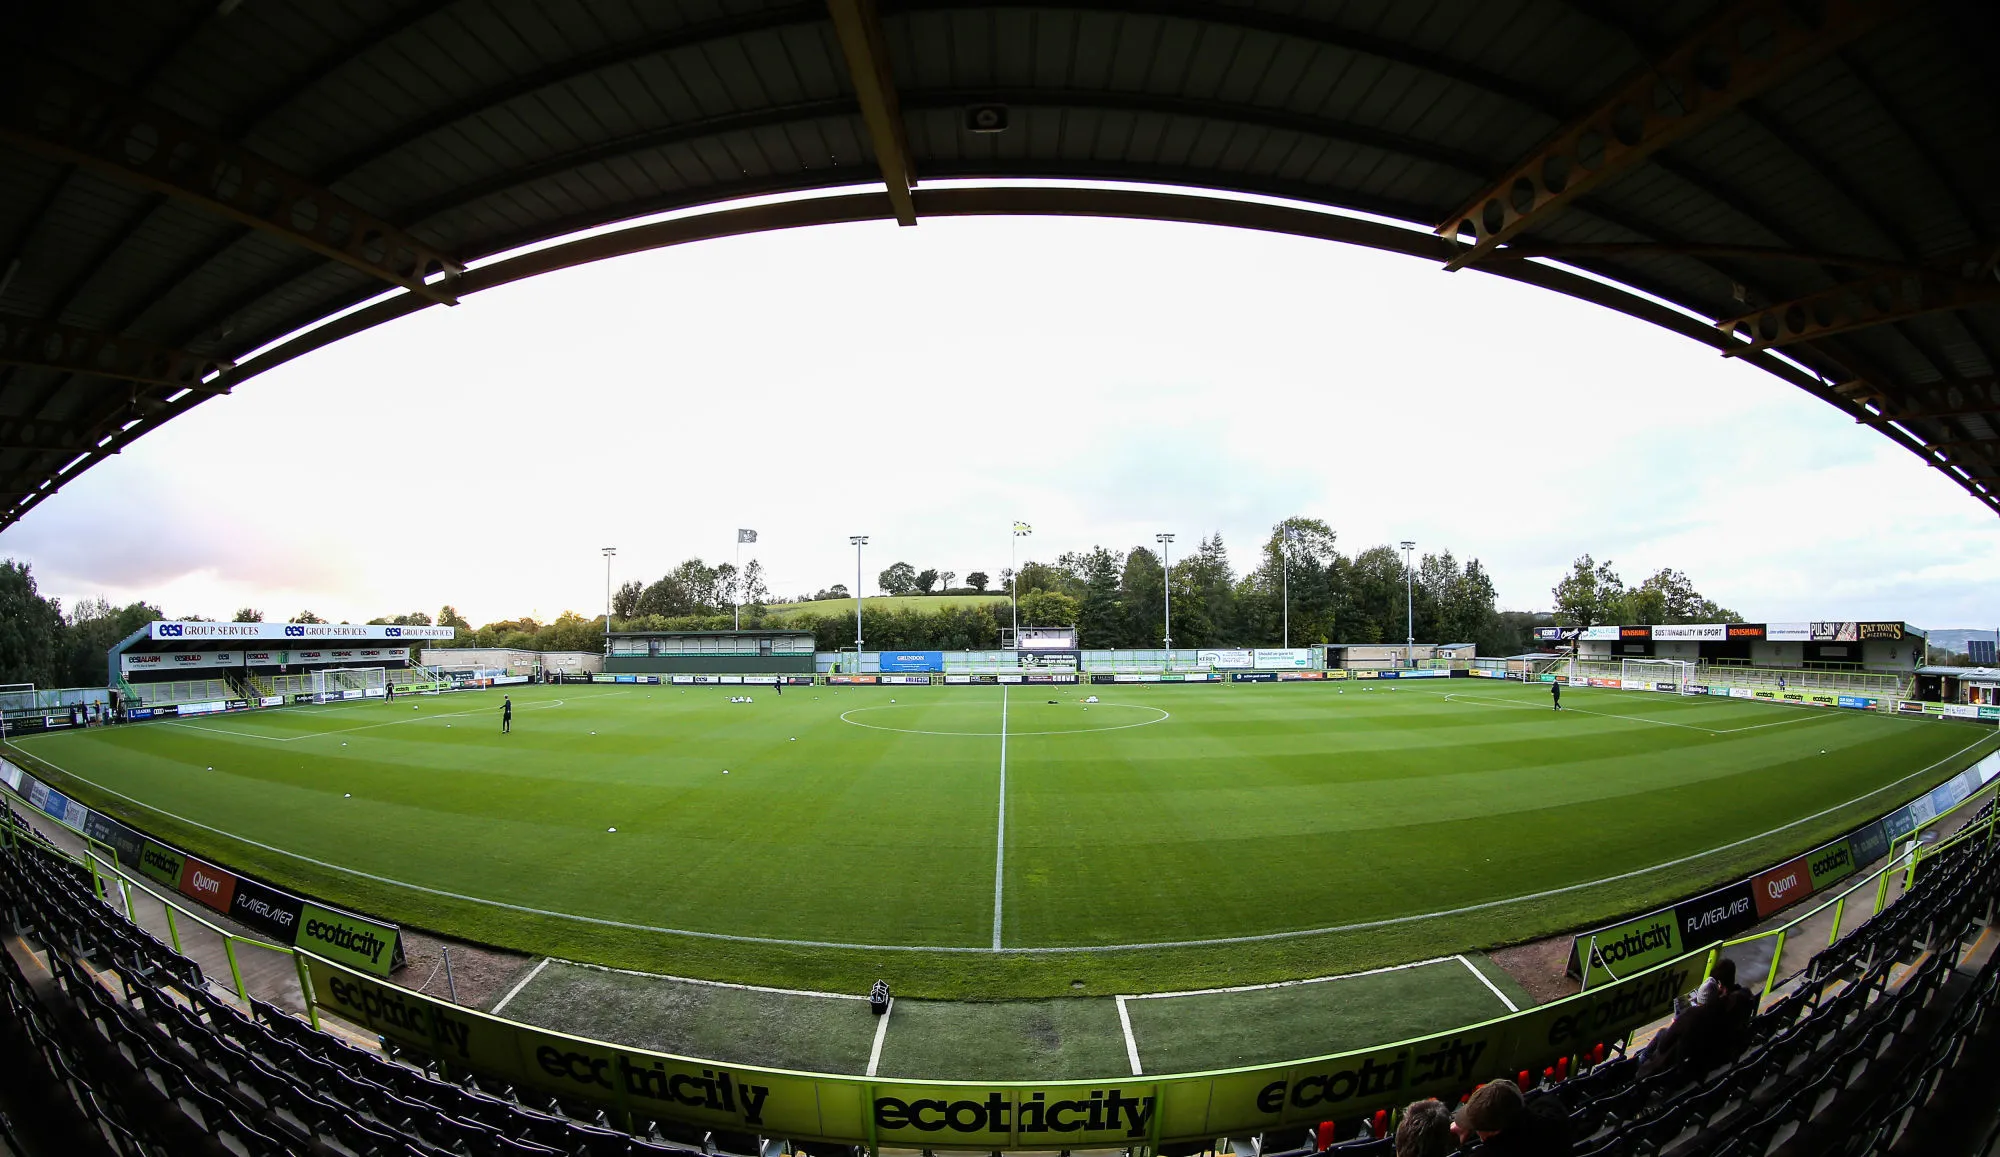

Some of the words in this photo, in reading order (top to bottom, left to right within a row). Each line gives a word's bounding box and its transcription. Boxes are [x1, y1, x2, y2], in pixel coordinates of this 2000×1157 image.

[185, 626, 216, 636] GROUP
[217, 626, 259, 636] SERVICES
[306, 627, 332, 636] GROUP
[333, 627, 367, 636] SERVICES
[402, 628, 424, 636] GROUP
[425, 629, 453, 637] SERVICES
[1621, 629, 1646, 637] RENISHAW
[1654, 629, 1695, 637] SUSTAINABILITY
[1704, 629, 1722, 637] SPORT
[1729, 628, 1758, 636] RENISHAW
[1811, 623, 1835, 635] PULSIN
[1859, 624, 1876, 639] FAT
[144, 850, 180, 881] ecotricity
[1812, 847, 1850, 878] ecotricity
[193, 871, 219, 894] Quorn
[1768, 874, 1798, 899] Quorn
[236, 893, 294, 927] PLAYERLAYER
[1687, 897, 1749, 933] PLAYERLAYER
[306, 919, 386, 965] ecotricity
[1590, 922, 1672, 969] ecotricity
[873, 1090, 1157, 1138] ecotricity
